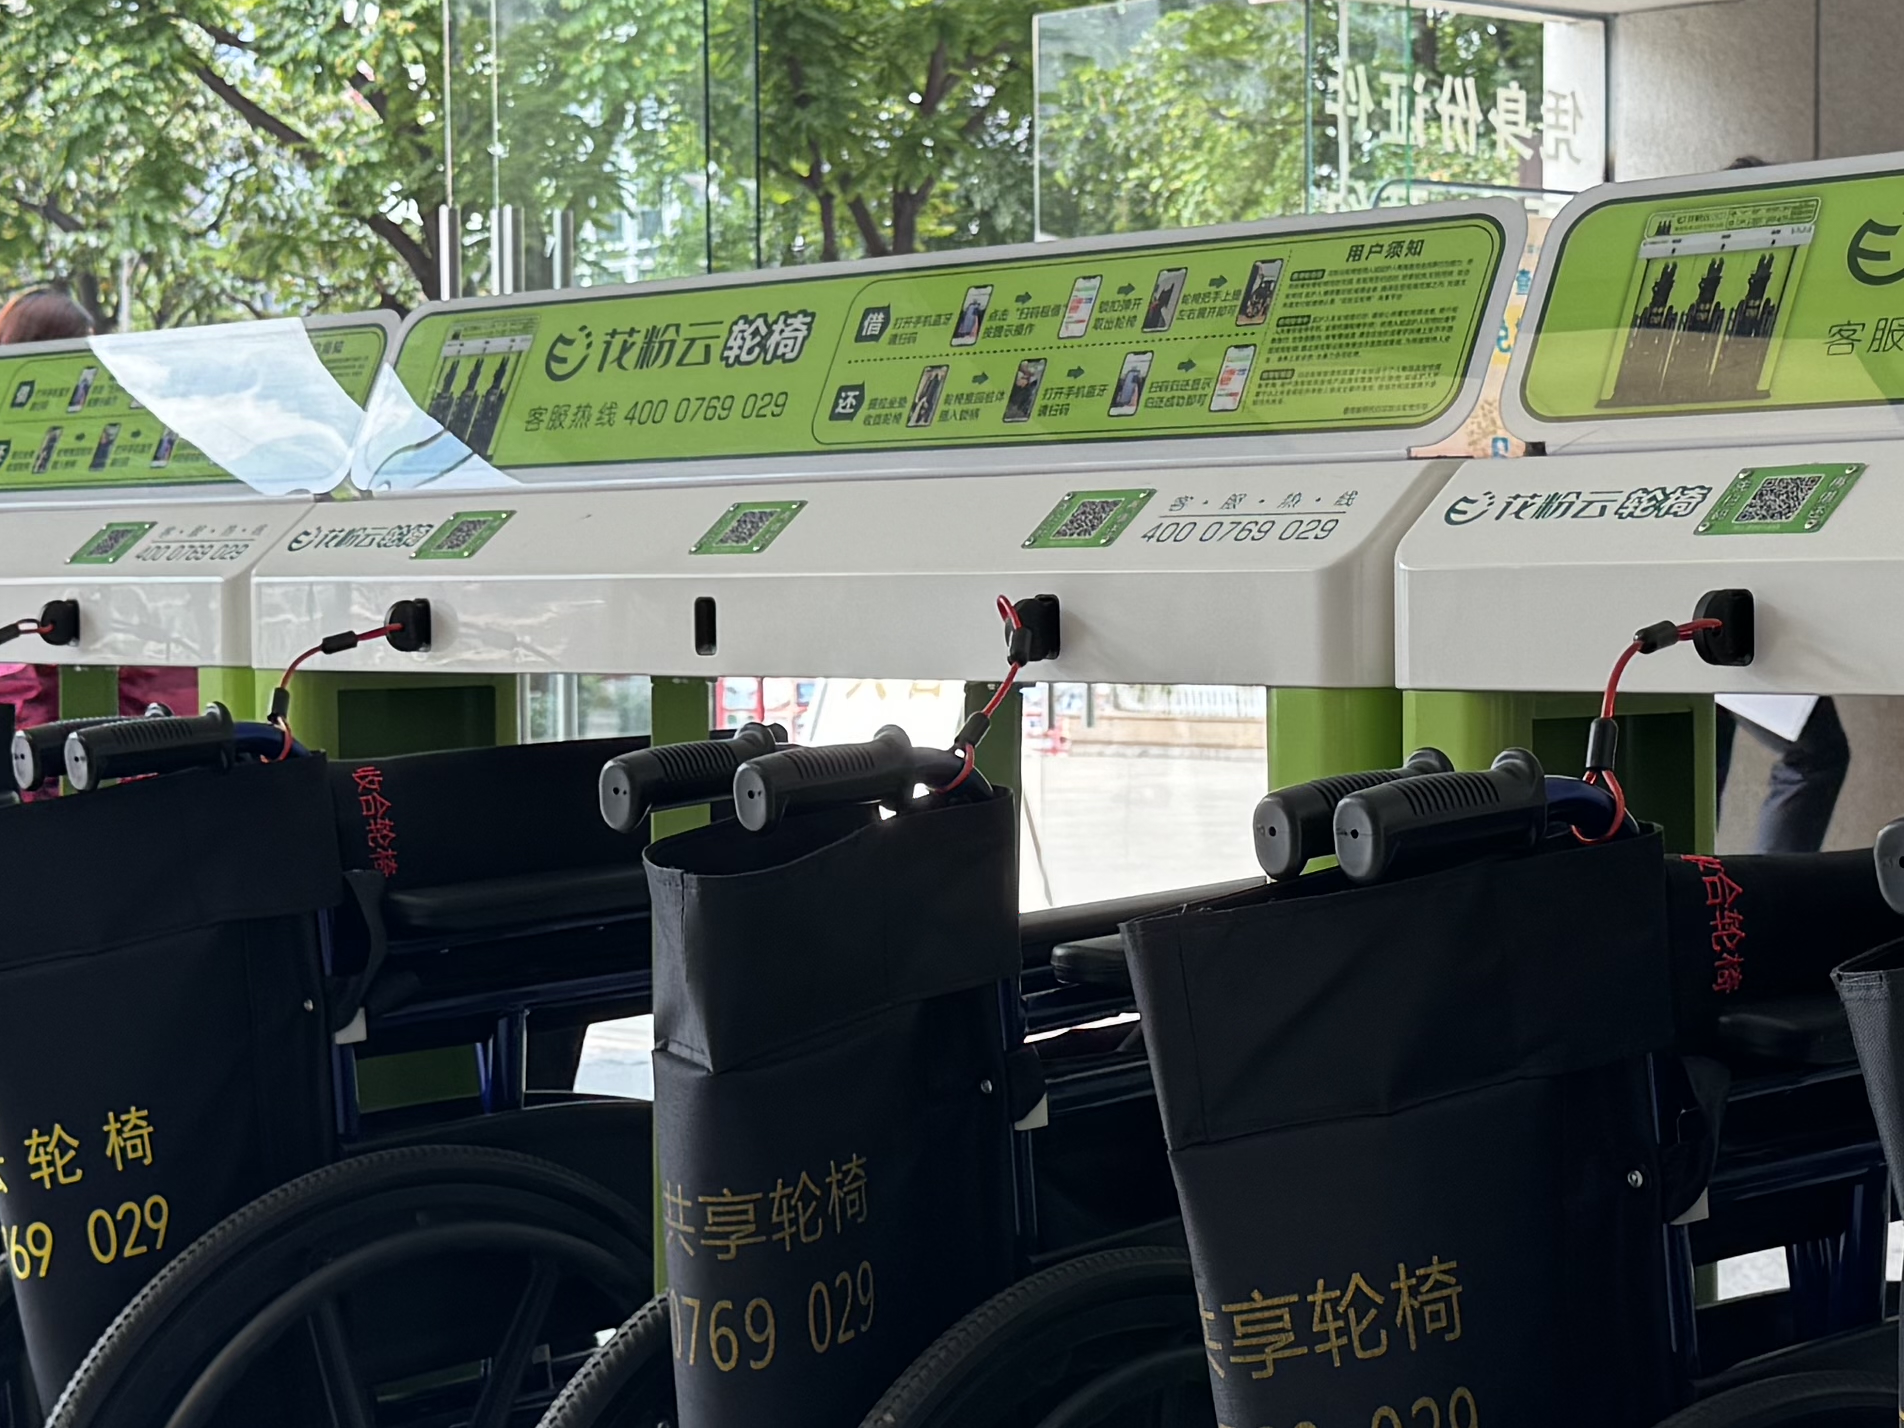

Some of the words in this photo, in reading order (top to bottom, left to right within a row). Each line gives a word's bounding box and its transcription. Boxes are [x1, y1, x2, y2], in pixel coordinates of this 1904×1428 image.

[1346, 239, 1425, 262] 用户须知
[597, 309, 816, 372] 花粉云轮椅
[861, 312, 885, 336] 借
[525, 401, 618, 432] 客服热线
[624, 399, 669, 425] 400
[674, 394, 736, 423] 0769
[741, 391, 789, 418] 029
[834, 390, 860, 414] 还
[1494, 484, 1713, 521] 花粉云轮椅
[1140, 522, 1197, 544] 400
[1199, 520, 1275, 543] 0769
[1278, 519, 1340, 541] 029
[663, 1153, 867, 1261] 共享轮椅
[1, 1221, 53, 1280] 69
[87, 1194, 169, 1264] 029
[669, 1288, 776, 1372] 0769
[808, 1260, 874, 1353] 029
